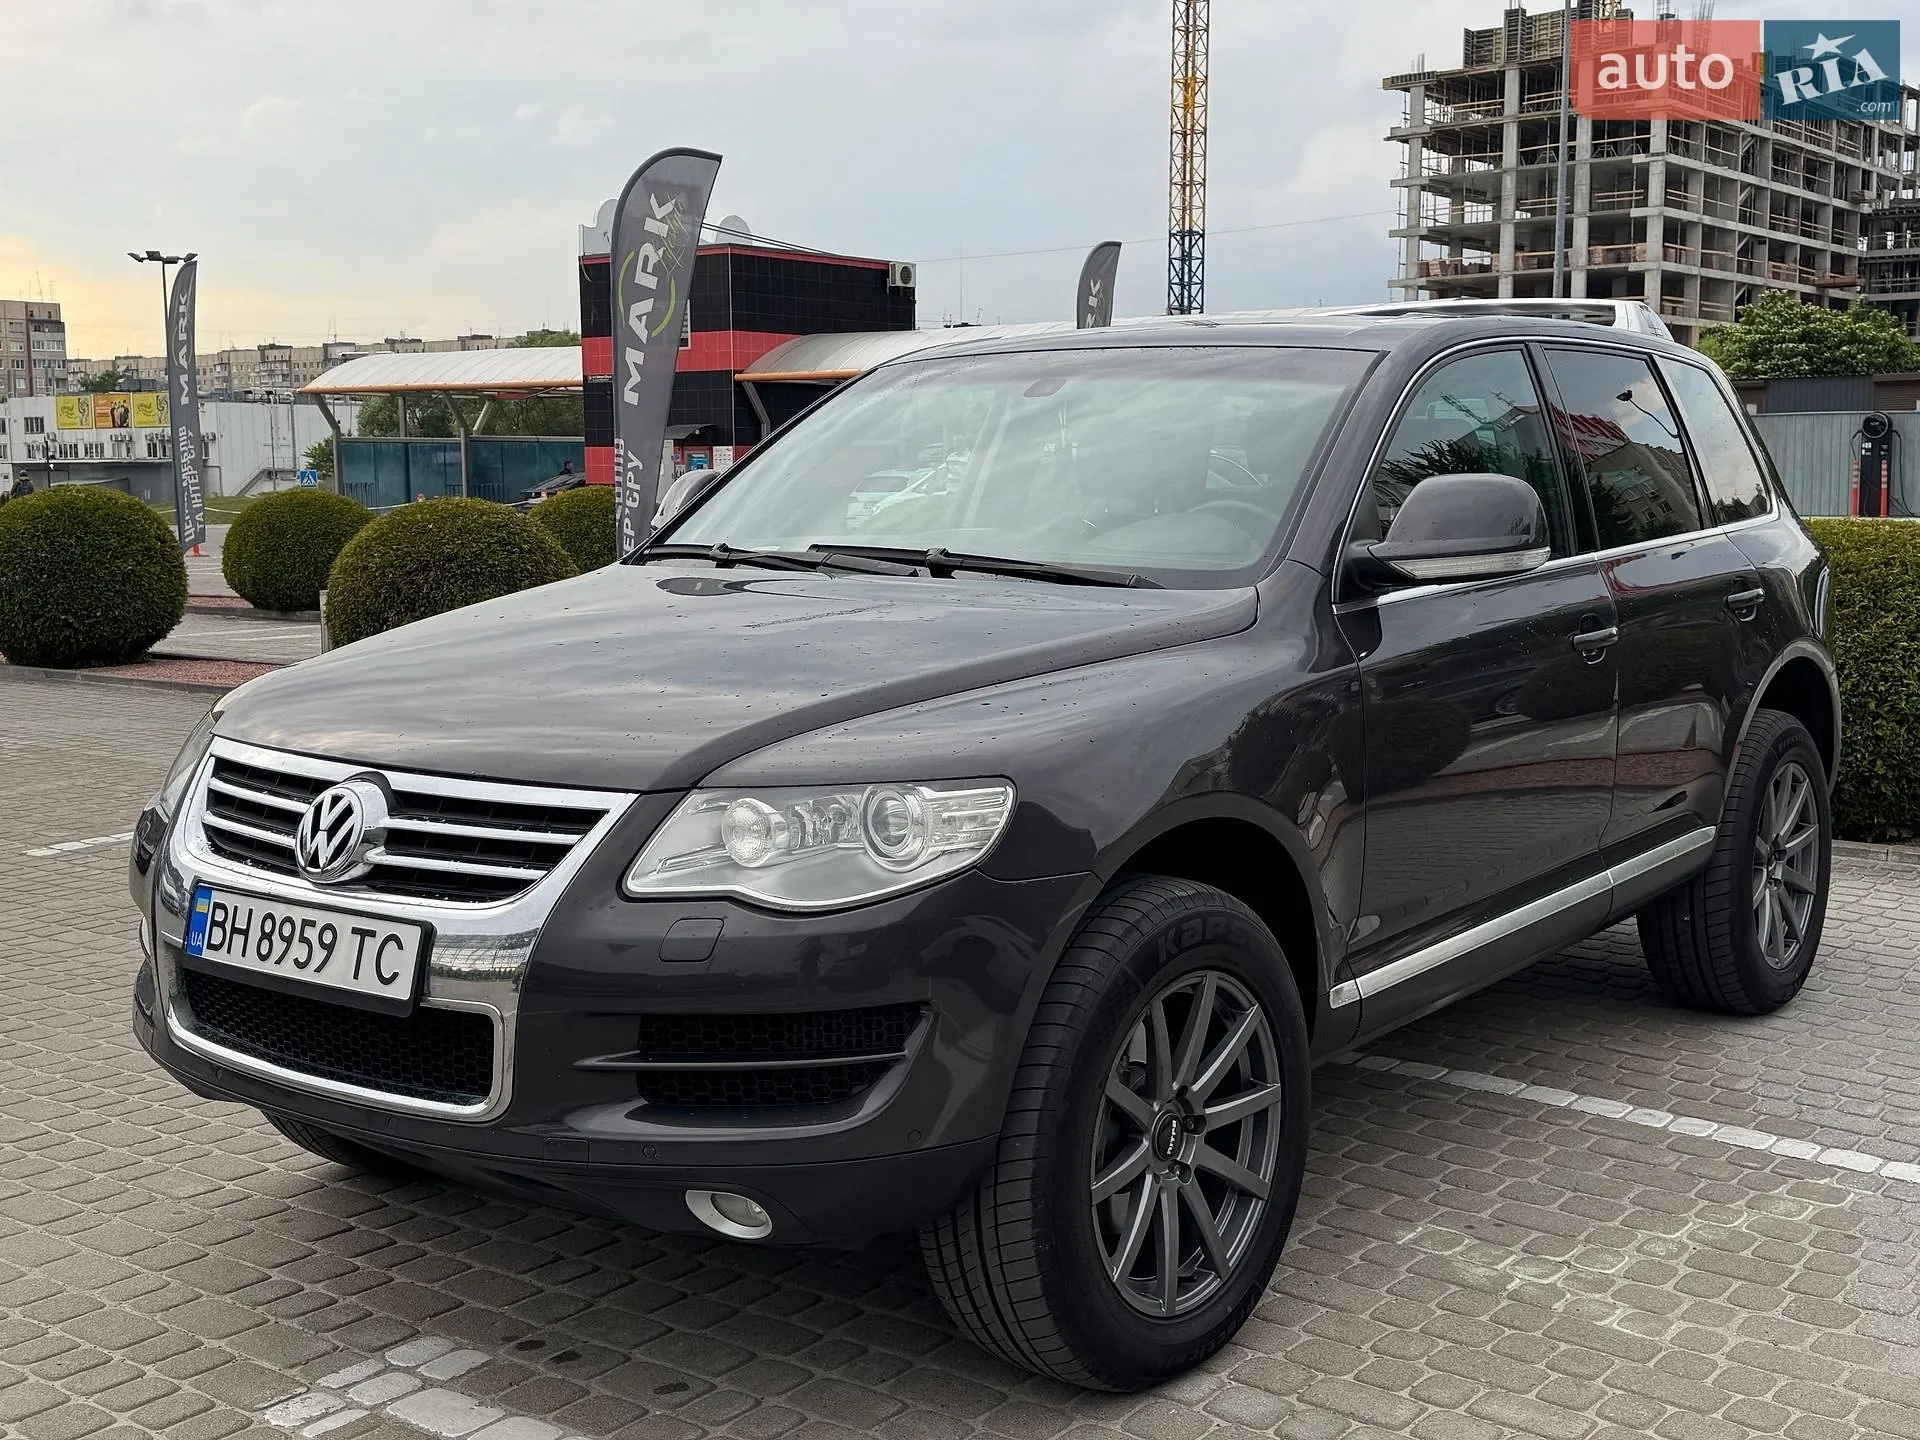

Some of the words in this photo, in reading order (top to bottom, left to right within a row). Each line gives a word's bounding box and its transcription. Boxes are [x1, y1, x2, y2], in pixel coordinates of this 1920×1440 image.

[623, 192, 677, 406] MARK
[178, 292, 190, 406] MARK
[190, 930, 203, 948] UA
[205, 901, 254, 958] BH
[256, 911, 338, 974] 8959
[350, 926, 404, 986] TC
